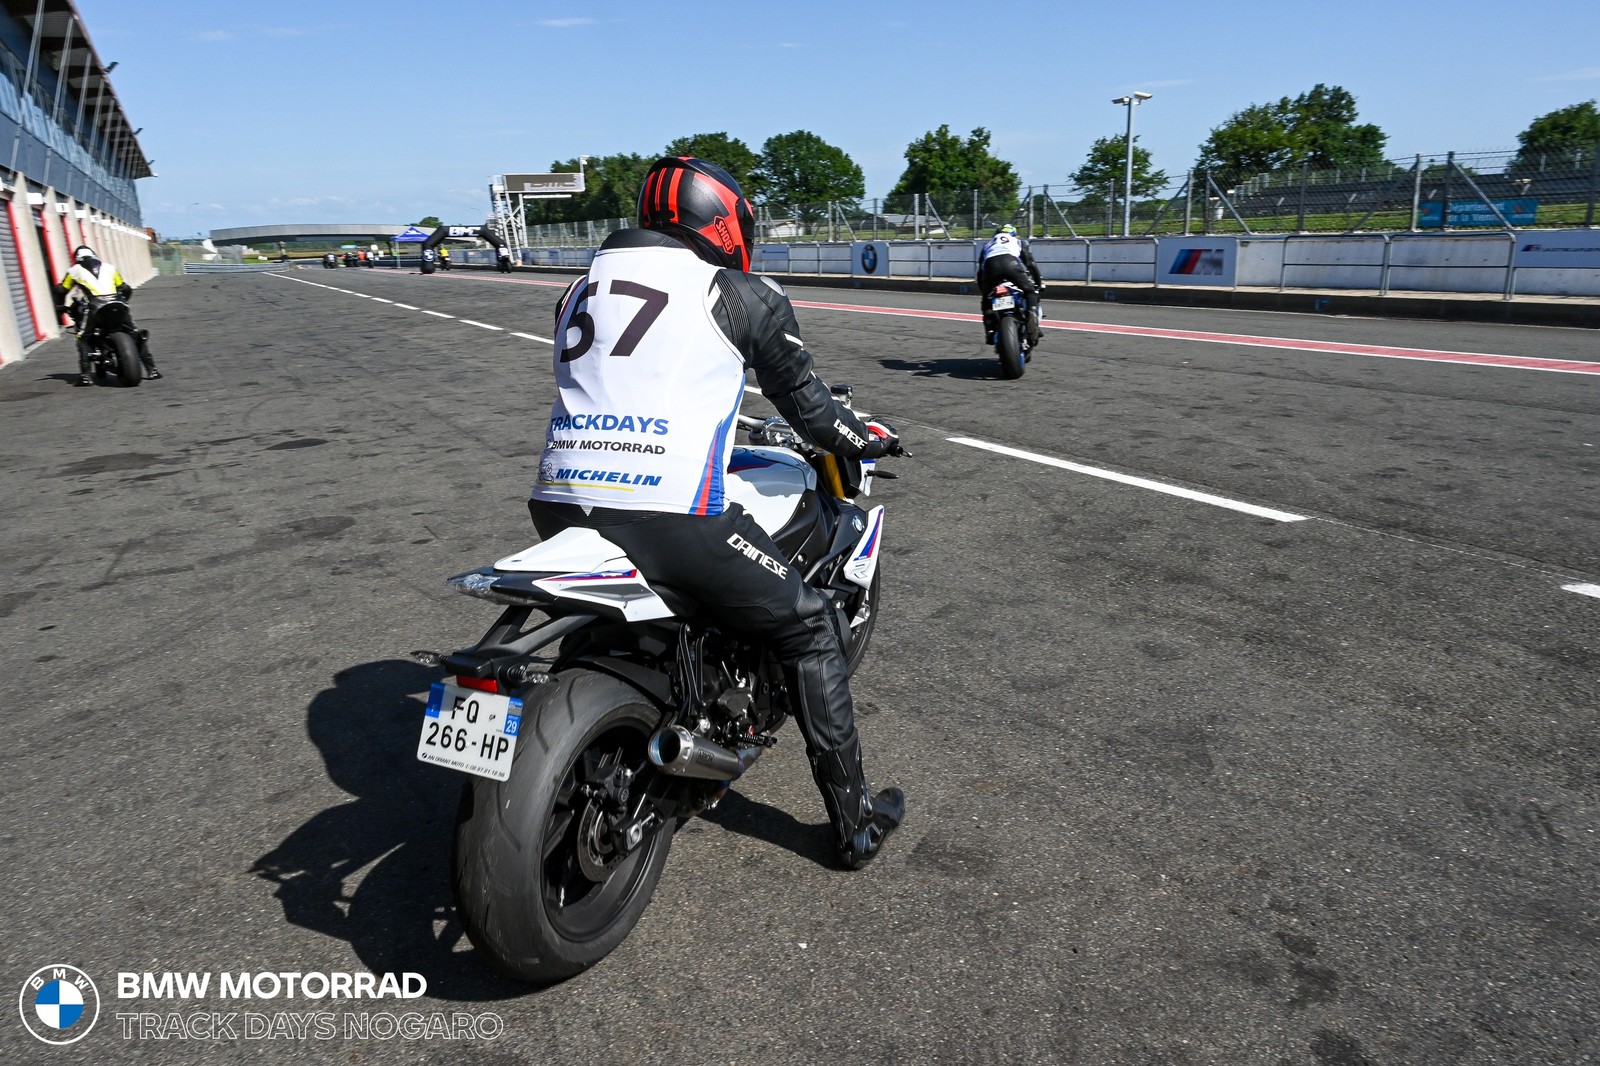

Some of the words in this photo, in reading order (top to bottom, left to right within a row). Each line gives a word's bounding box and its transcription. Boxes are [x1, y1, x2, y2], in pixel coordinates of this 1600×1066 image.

[1450, 202, 1504, 212] Départemnt
[716, 219, 733, 251] SHOEI
[560, 279, 669, 363] 67
[550, 414, 669, 435] TRACKDAYS
[833, 418, 868, 450] DAINESE
[551, 440, 578, 450] BMW
[579, 440, 666, 455] MOTORRAD
[556, 468, 662, 486] MICHELIN
[726, 532, 788, 580] DAINESE
[451, 696, 479, 724] FQ
[505, 719, 518, 734] 29
